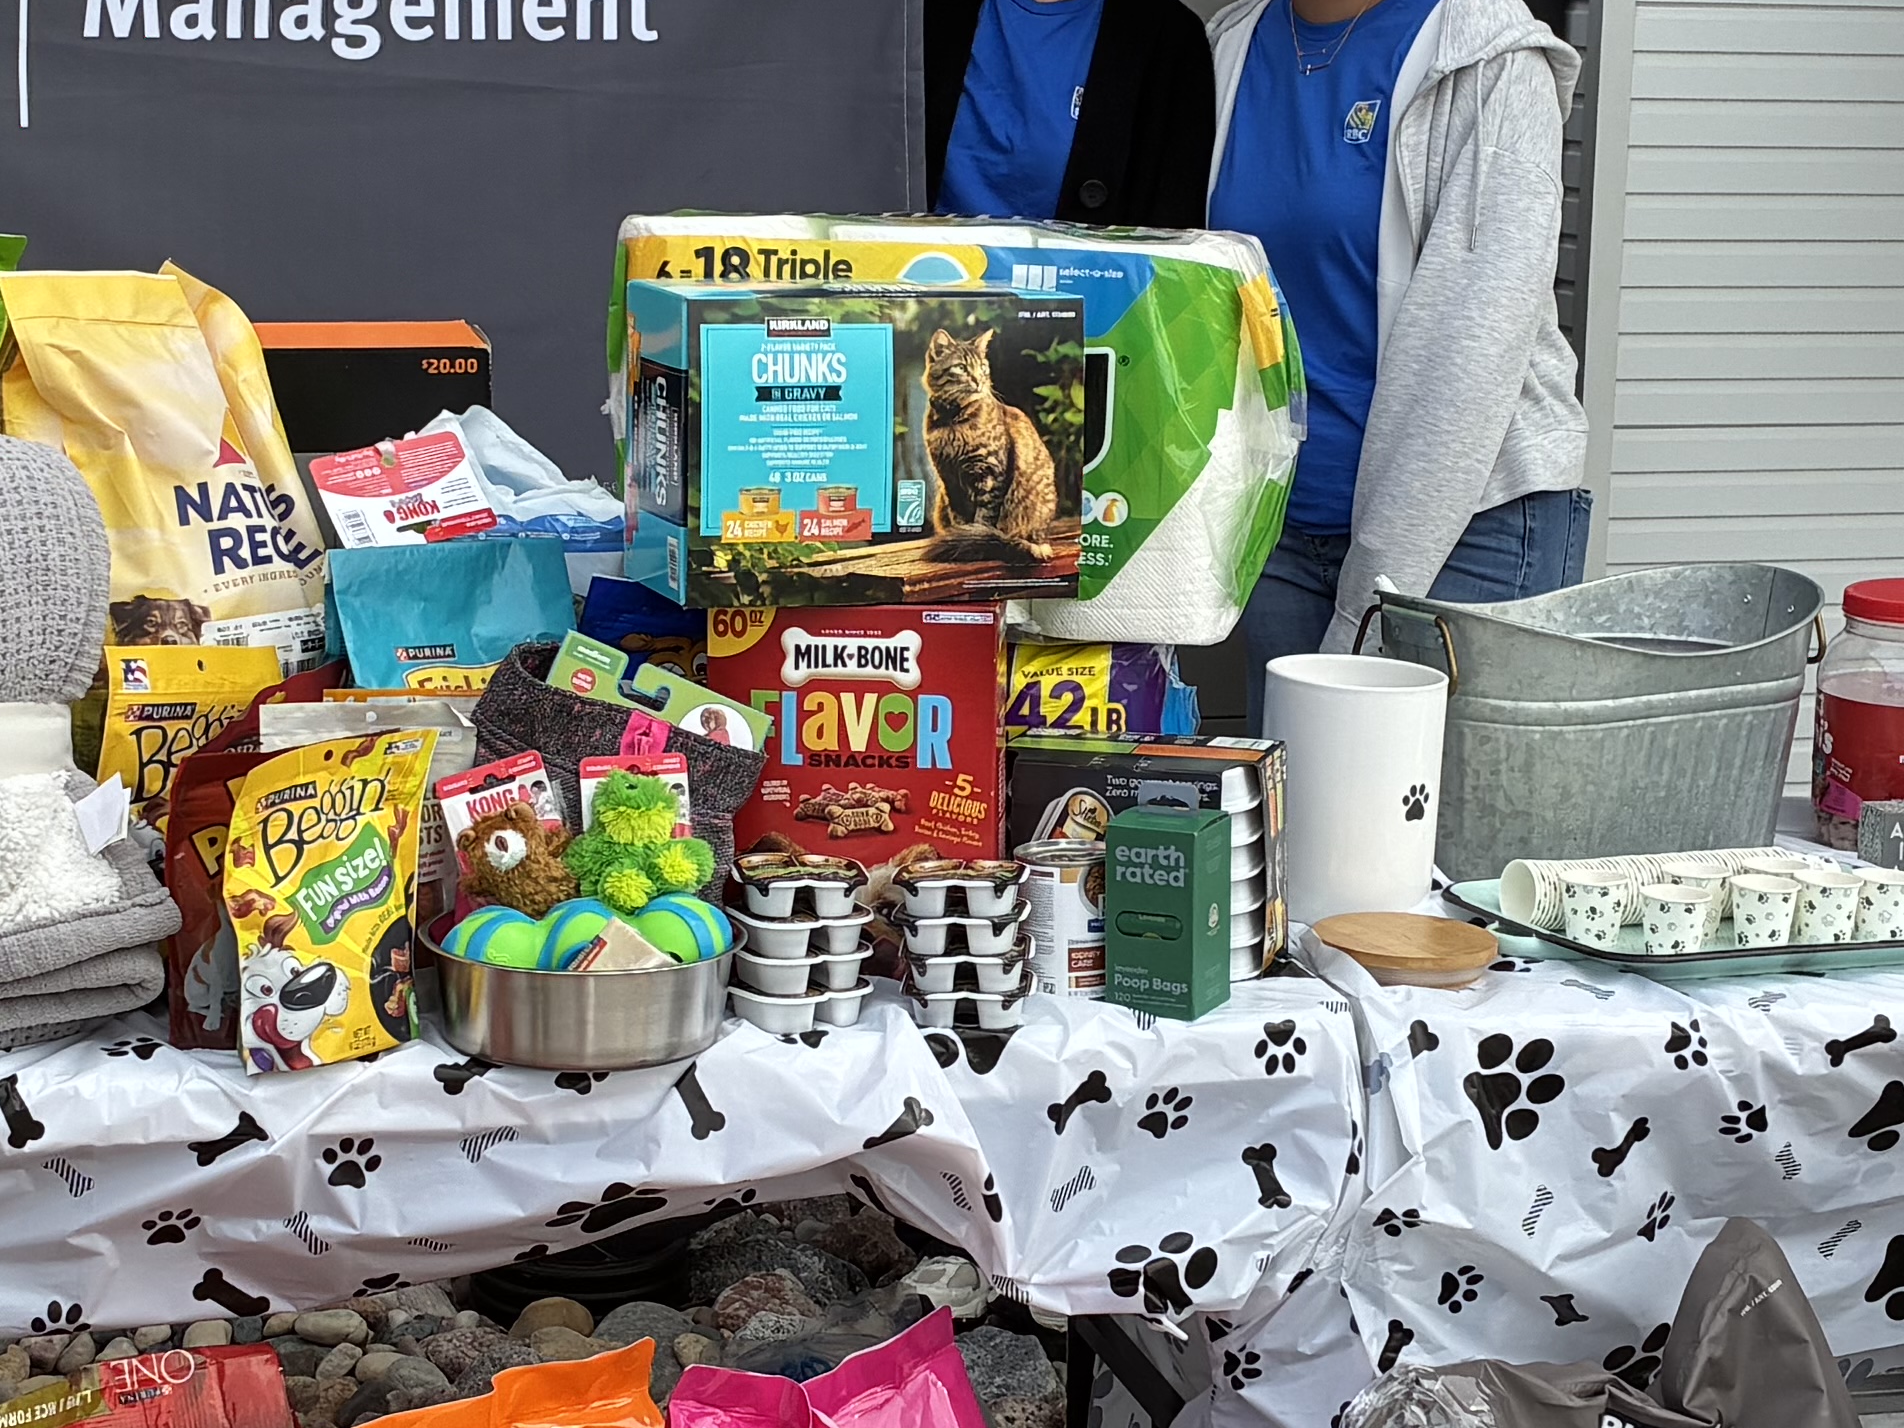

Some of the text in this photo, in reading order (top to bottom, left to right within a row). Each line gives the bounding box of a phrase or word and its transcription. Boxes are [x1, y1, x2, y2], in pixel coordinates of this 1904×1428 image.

[1344, 128, 1367, 144] RBC
[695, 246, 852, 282] 18 Triple
[769, 320, 828, 331] KIRKLAND
[421, 357, 478, 374] $20.00
[752, 354, 846, 383] CHUNKS
[785, 388, 826, 399] GRAVY
[727, 520, 742, 538] 24
[803, 519, 819, 536] 24
[712, 611, 745, 638] 60
[408, 646, 454, 658] PURINA
[1021, 665, 1096, 678] VALUE SIZE
[142, 704, 194, 719] PURINA
[1005, 680, 1086, 731] 42
[808, 753, 910, 769] SNACKS
[267, 784, 316, 807] PURINA
[466, 791, 515, 822] KONG
[929, 791, 987, 821] DELICIOUS
[1115, 846, 1184, 866] earth
[1115, 866, 1185, 887] rated
[1114, 973, 1188, 995] Poop Bags
[110, 1349, 195, 1388] ONE
